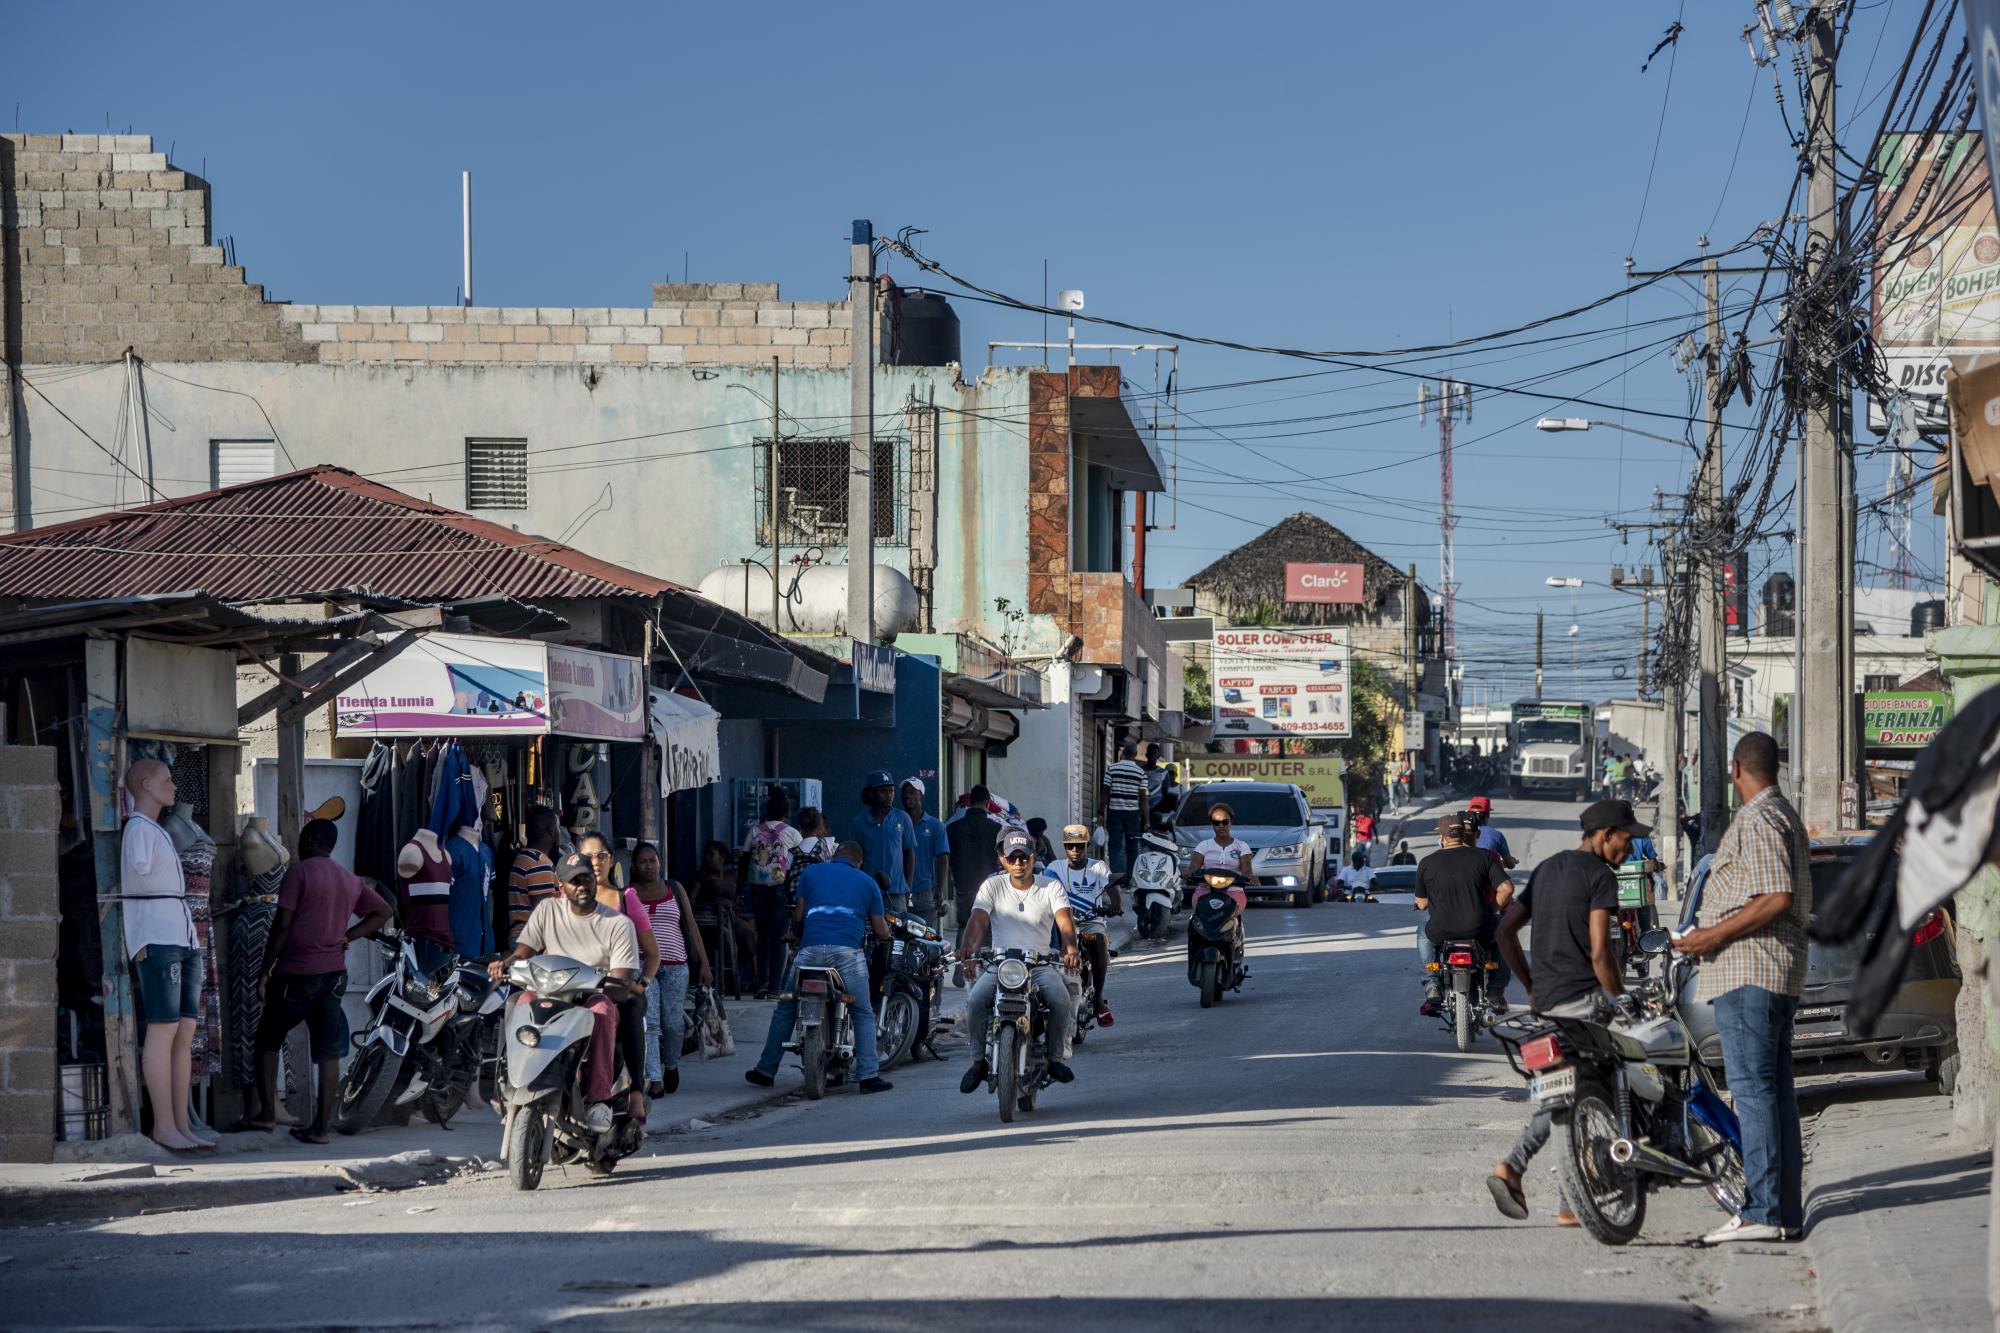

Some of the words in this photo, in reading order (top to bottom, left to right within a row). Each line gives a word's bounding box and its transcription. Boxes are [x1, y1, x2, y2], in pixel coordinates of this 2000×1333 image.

[1301, 574, 1341, 588] Claro
[1217, 633, 1259, 646] SOLER
[1263, 631, 1333, 645] COMPUTER
[573, 661, 595, 688] Lumia
[1221, 679, 1253, 687] LAPTOP
[1261, 685, 1296, 694] TABLET
[337, 697, 387, 708] Tienda
[391, 696, 434, 708] Lumia
[1881, 699, 1892, 709] DE
[1895, 699, 1928, 709] BANCAS
[1281, 722, 1345, 732] 809-833-4655
[1206, 761, 1305, 777] COMPUTER
